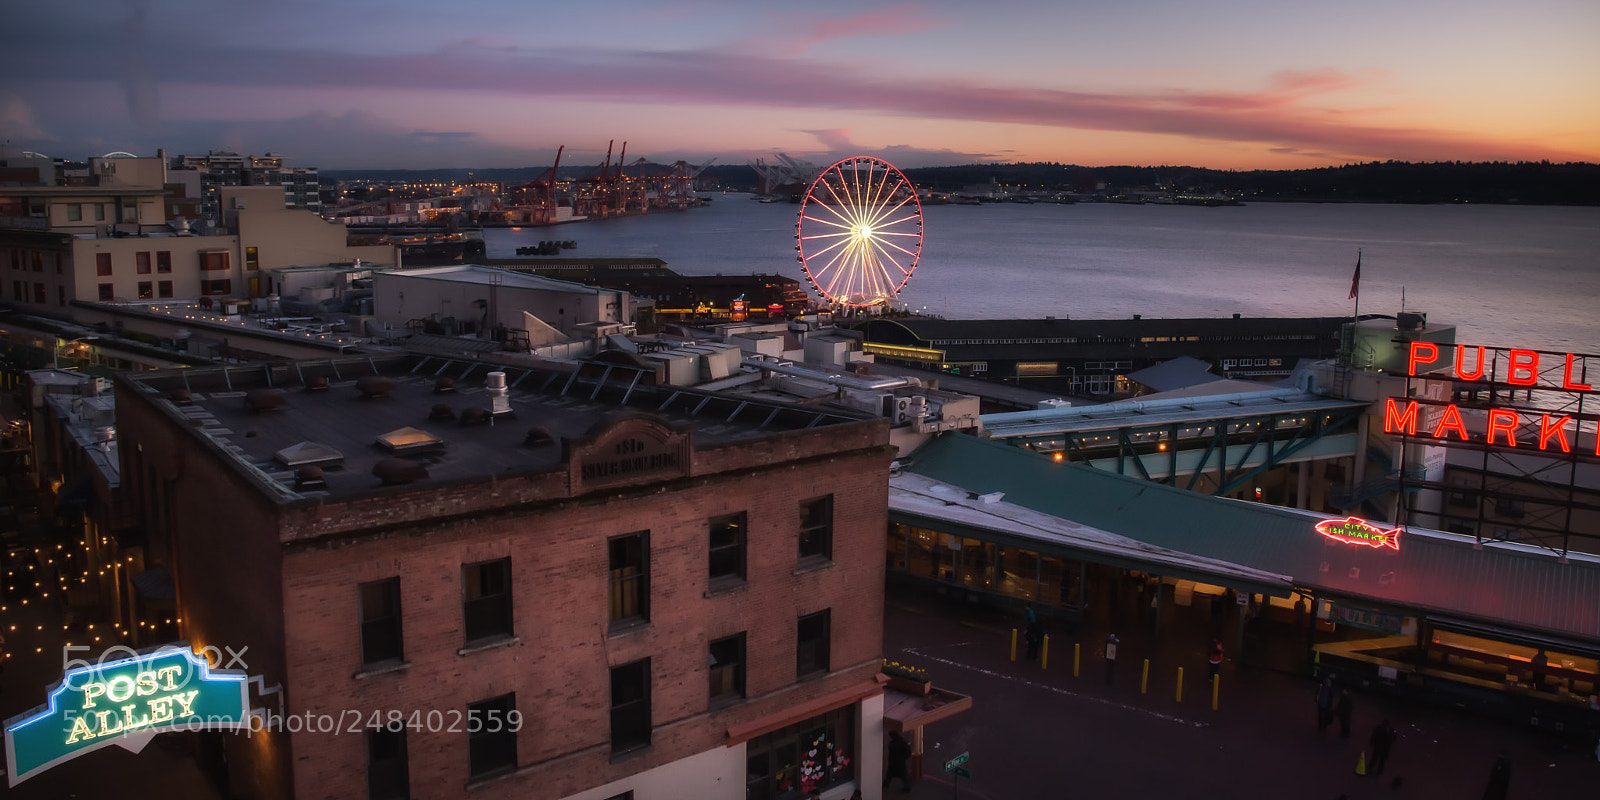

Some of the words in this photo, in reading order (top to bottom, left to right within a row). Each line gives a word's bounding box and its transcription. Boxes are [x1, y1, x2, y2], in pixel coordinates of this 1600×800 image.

[1384, 398, 1600, 456] MARK
[1323, 526, 1345, 535] FISH
[1348, 530, 1389, 542] MARKET
[1344, 522, 1369, 532] CITY
[81, 665, 182, 709] POST
[65, 690, 199, 745] ALLEY
